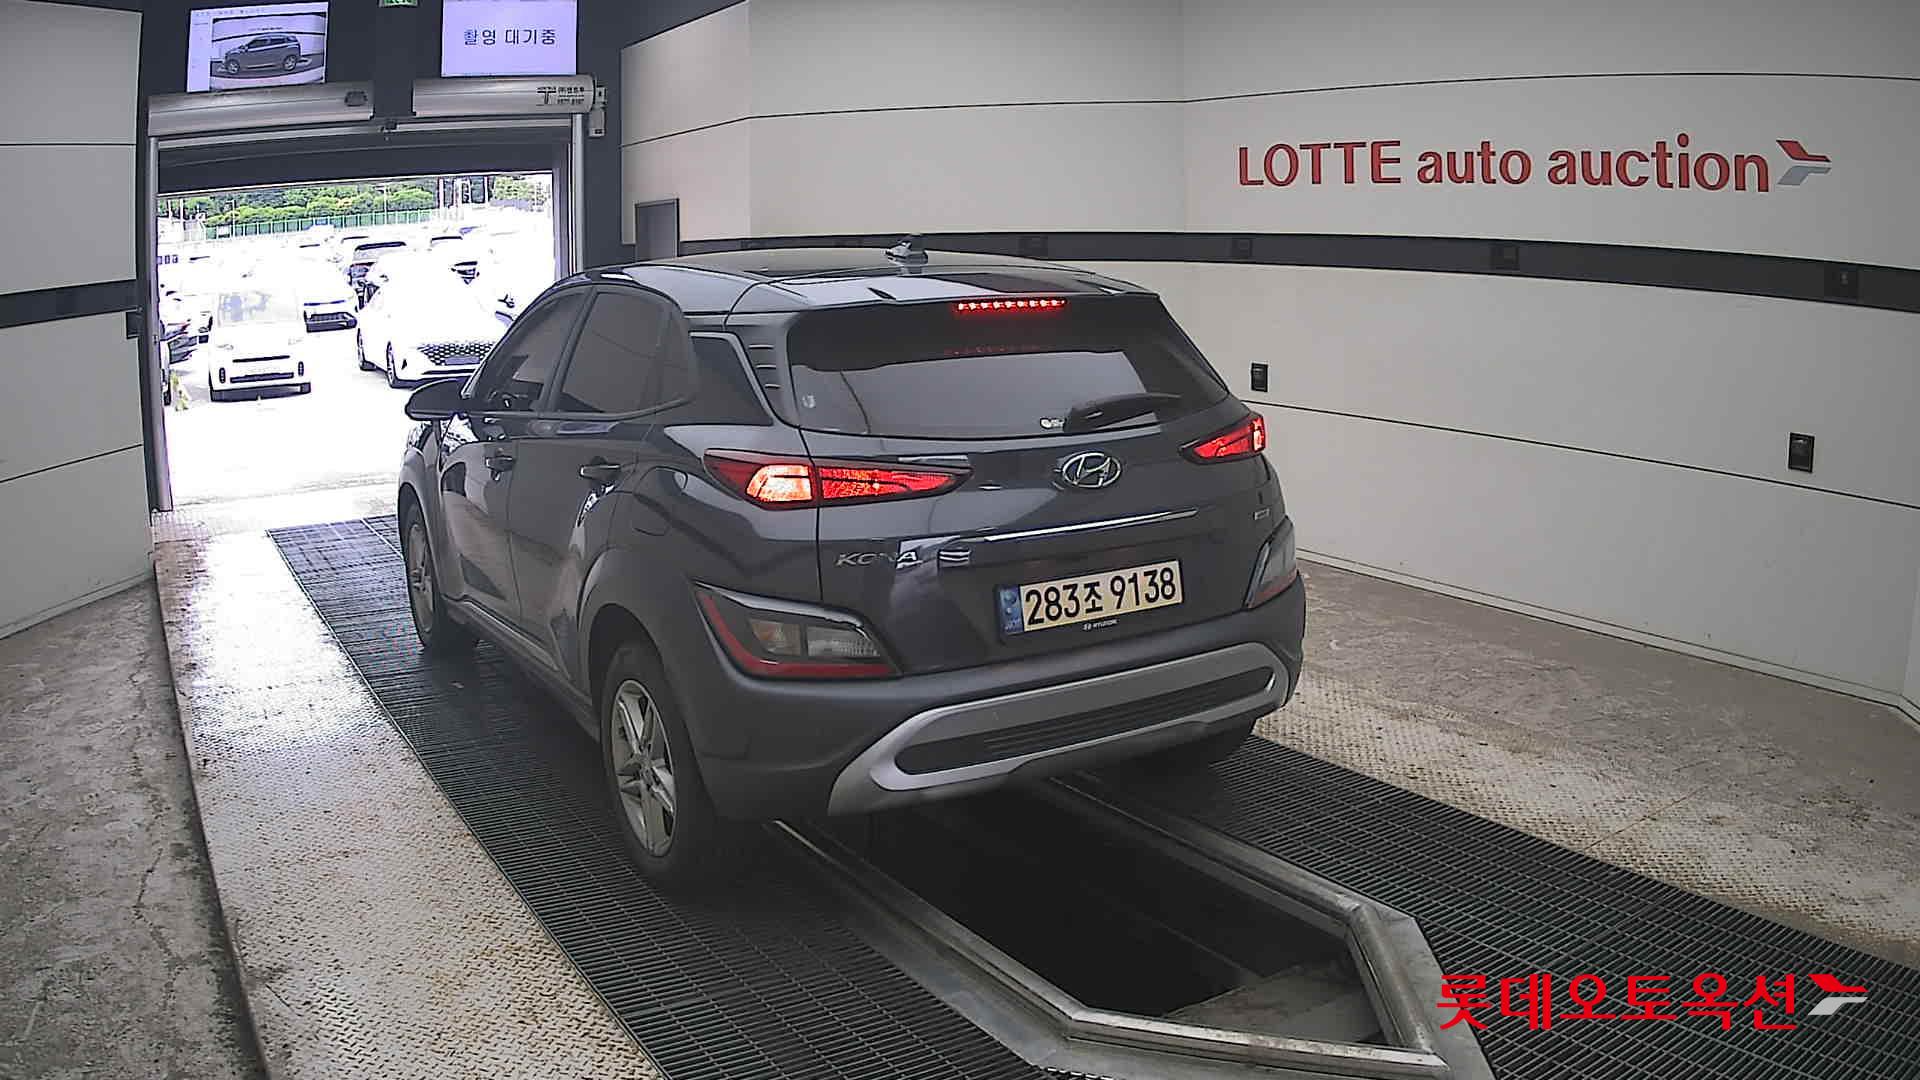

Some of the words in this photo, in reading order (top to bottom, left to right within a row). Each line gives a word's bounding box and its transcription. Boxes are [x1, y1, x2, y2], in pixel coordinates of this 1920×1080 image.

[504, 29, 556, 46] 대기중
[1238, 139, 1400, 187] LOTTE
[1416, 139, 1532, 185] auto
[1547, 133, 1769, 193] auction
[1025, 580, 1103, 626] 283조
[1110, 566, 1177, 610] 9138
